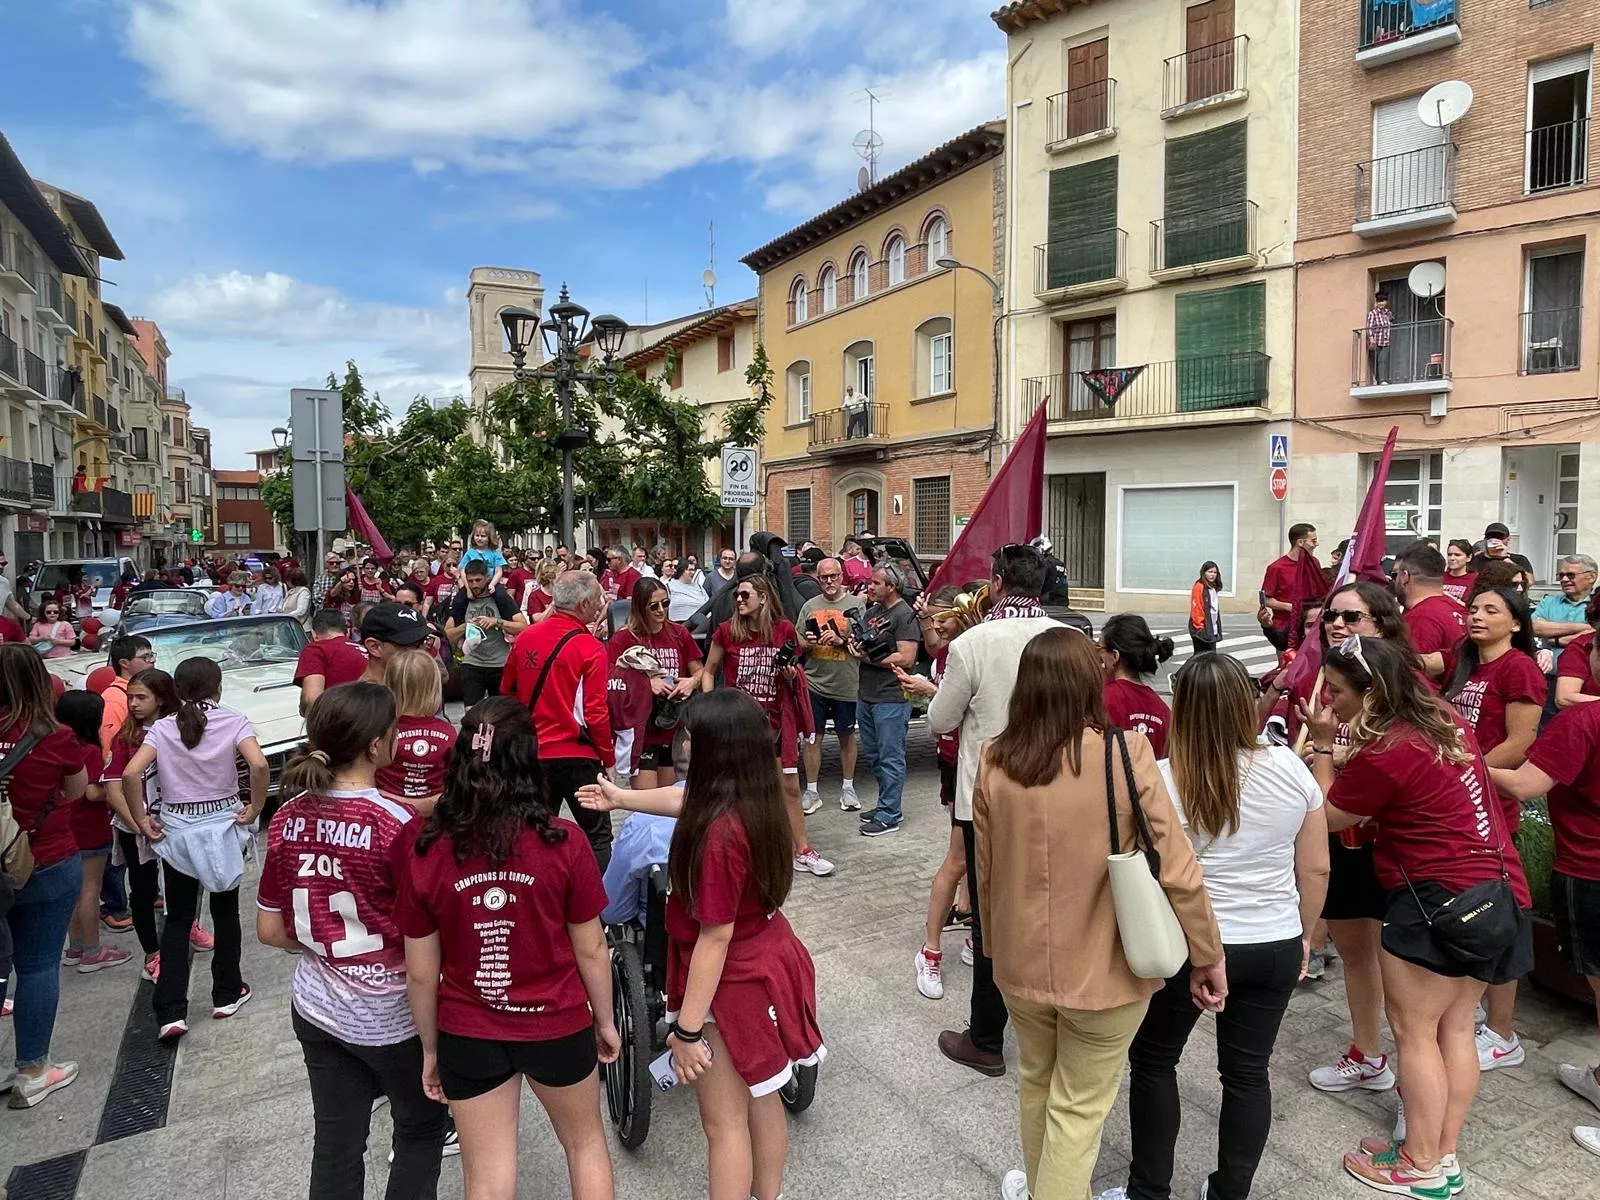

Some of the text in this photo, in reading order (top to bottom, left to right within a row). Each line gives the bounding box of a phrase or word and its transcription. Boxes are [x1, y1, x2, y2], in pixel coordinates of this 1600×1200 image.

[730, 460, 748, 472] 20
[1273, 478, 1286, 490] STOP
[738, 656, 773, 667] CAMPEON
[607, 678, 627, 691] FRAG
[168, 794, 239, 816] ELBOURNE
[316, 818, 372, 850] FRAGA
[297, 853, 344, 880] ZOE
[454, 871, 535, 893] CAMPEONAS DE EUROPA
[472, 895, 481, 906] 20
